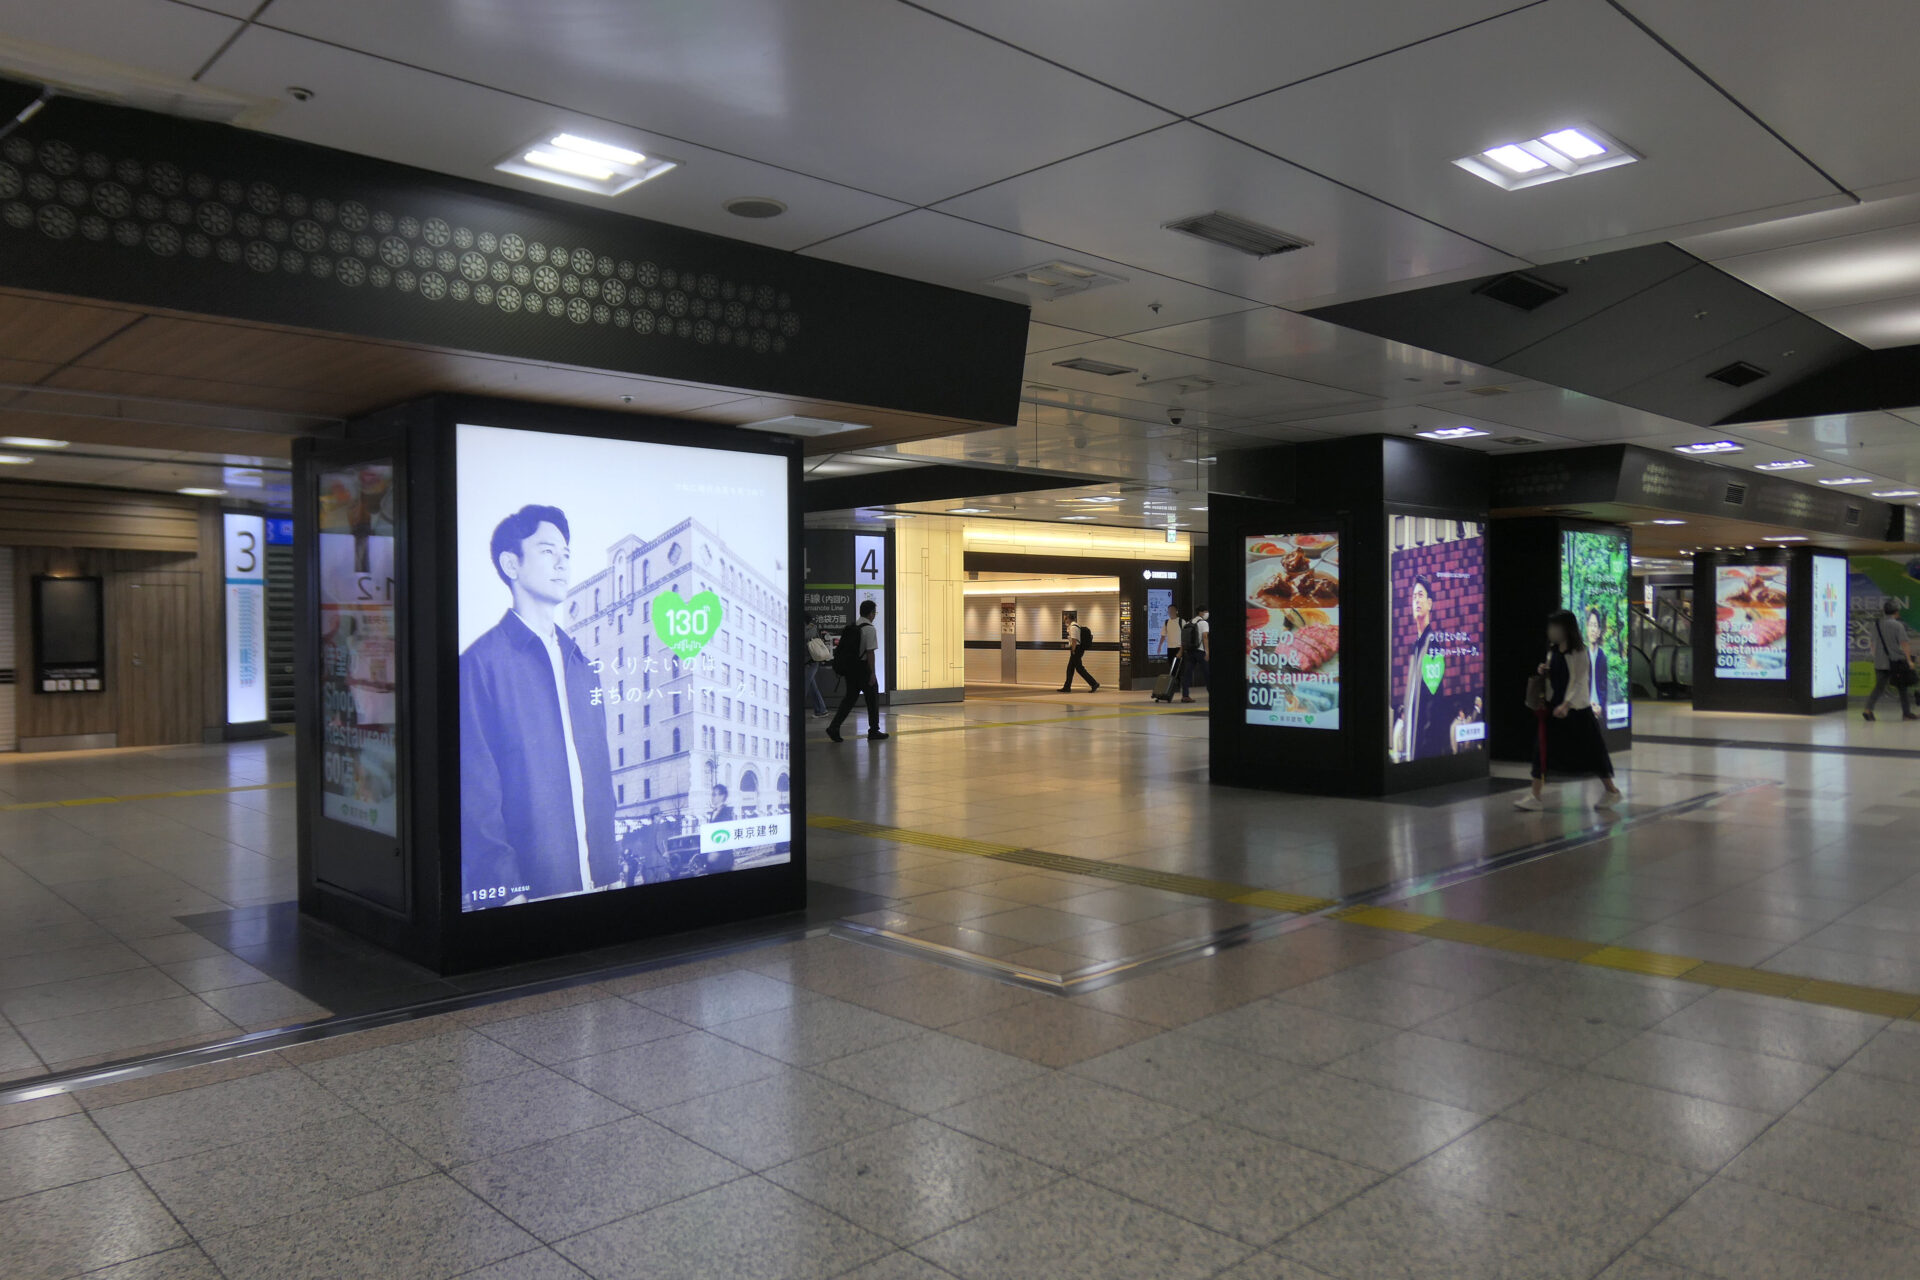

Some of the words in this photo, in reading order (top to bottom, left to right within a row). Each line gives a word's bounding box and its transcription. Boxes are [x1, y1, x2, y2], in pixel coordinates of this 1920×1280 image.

[236, 531, 256, 572] 3
[860, 549, 879, 580] 4
[1249, 649, 1301, 668] Shop&
[1249, 668, 1338, 684] Restaurant
[734, 824, 778, 840] 東京建物
[472, 886, 506, 901] 1929
[510, 885, 530, 893] YAESU
